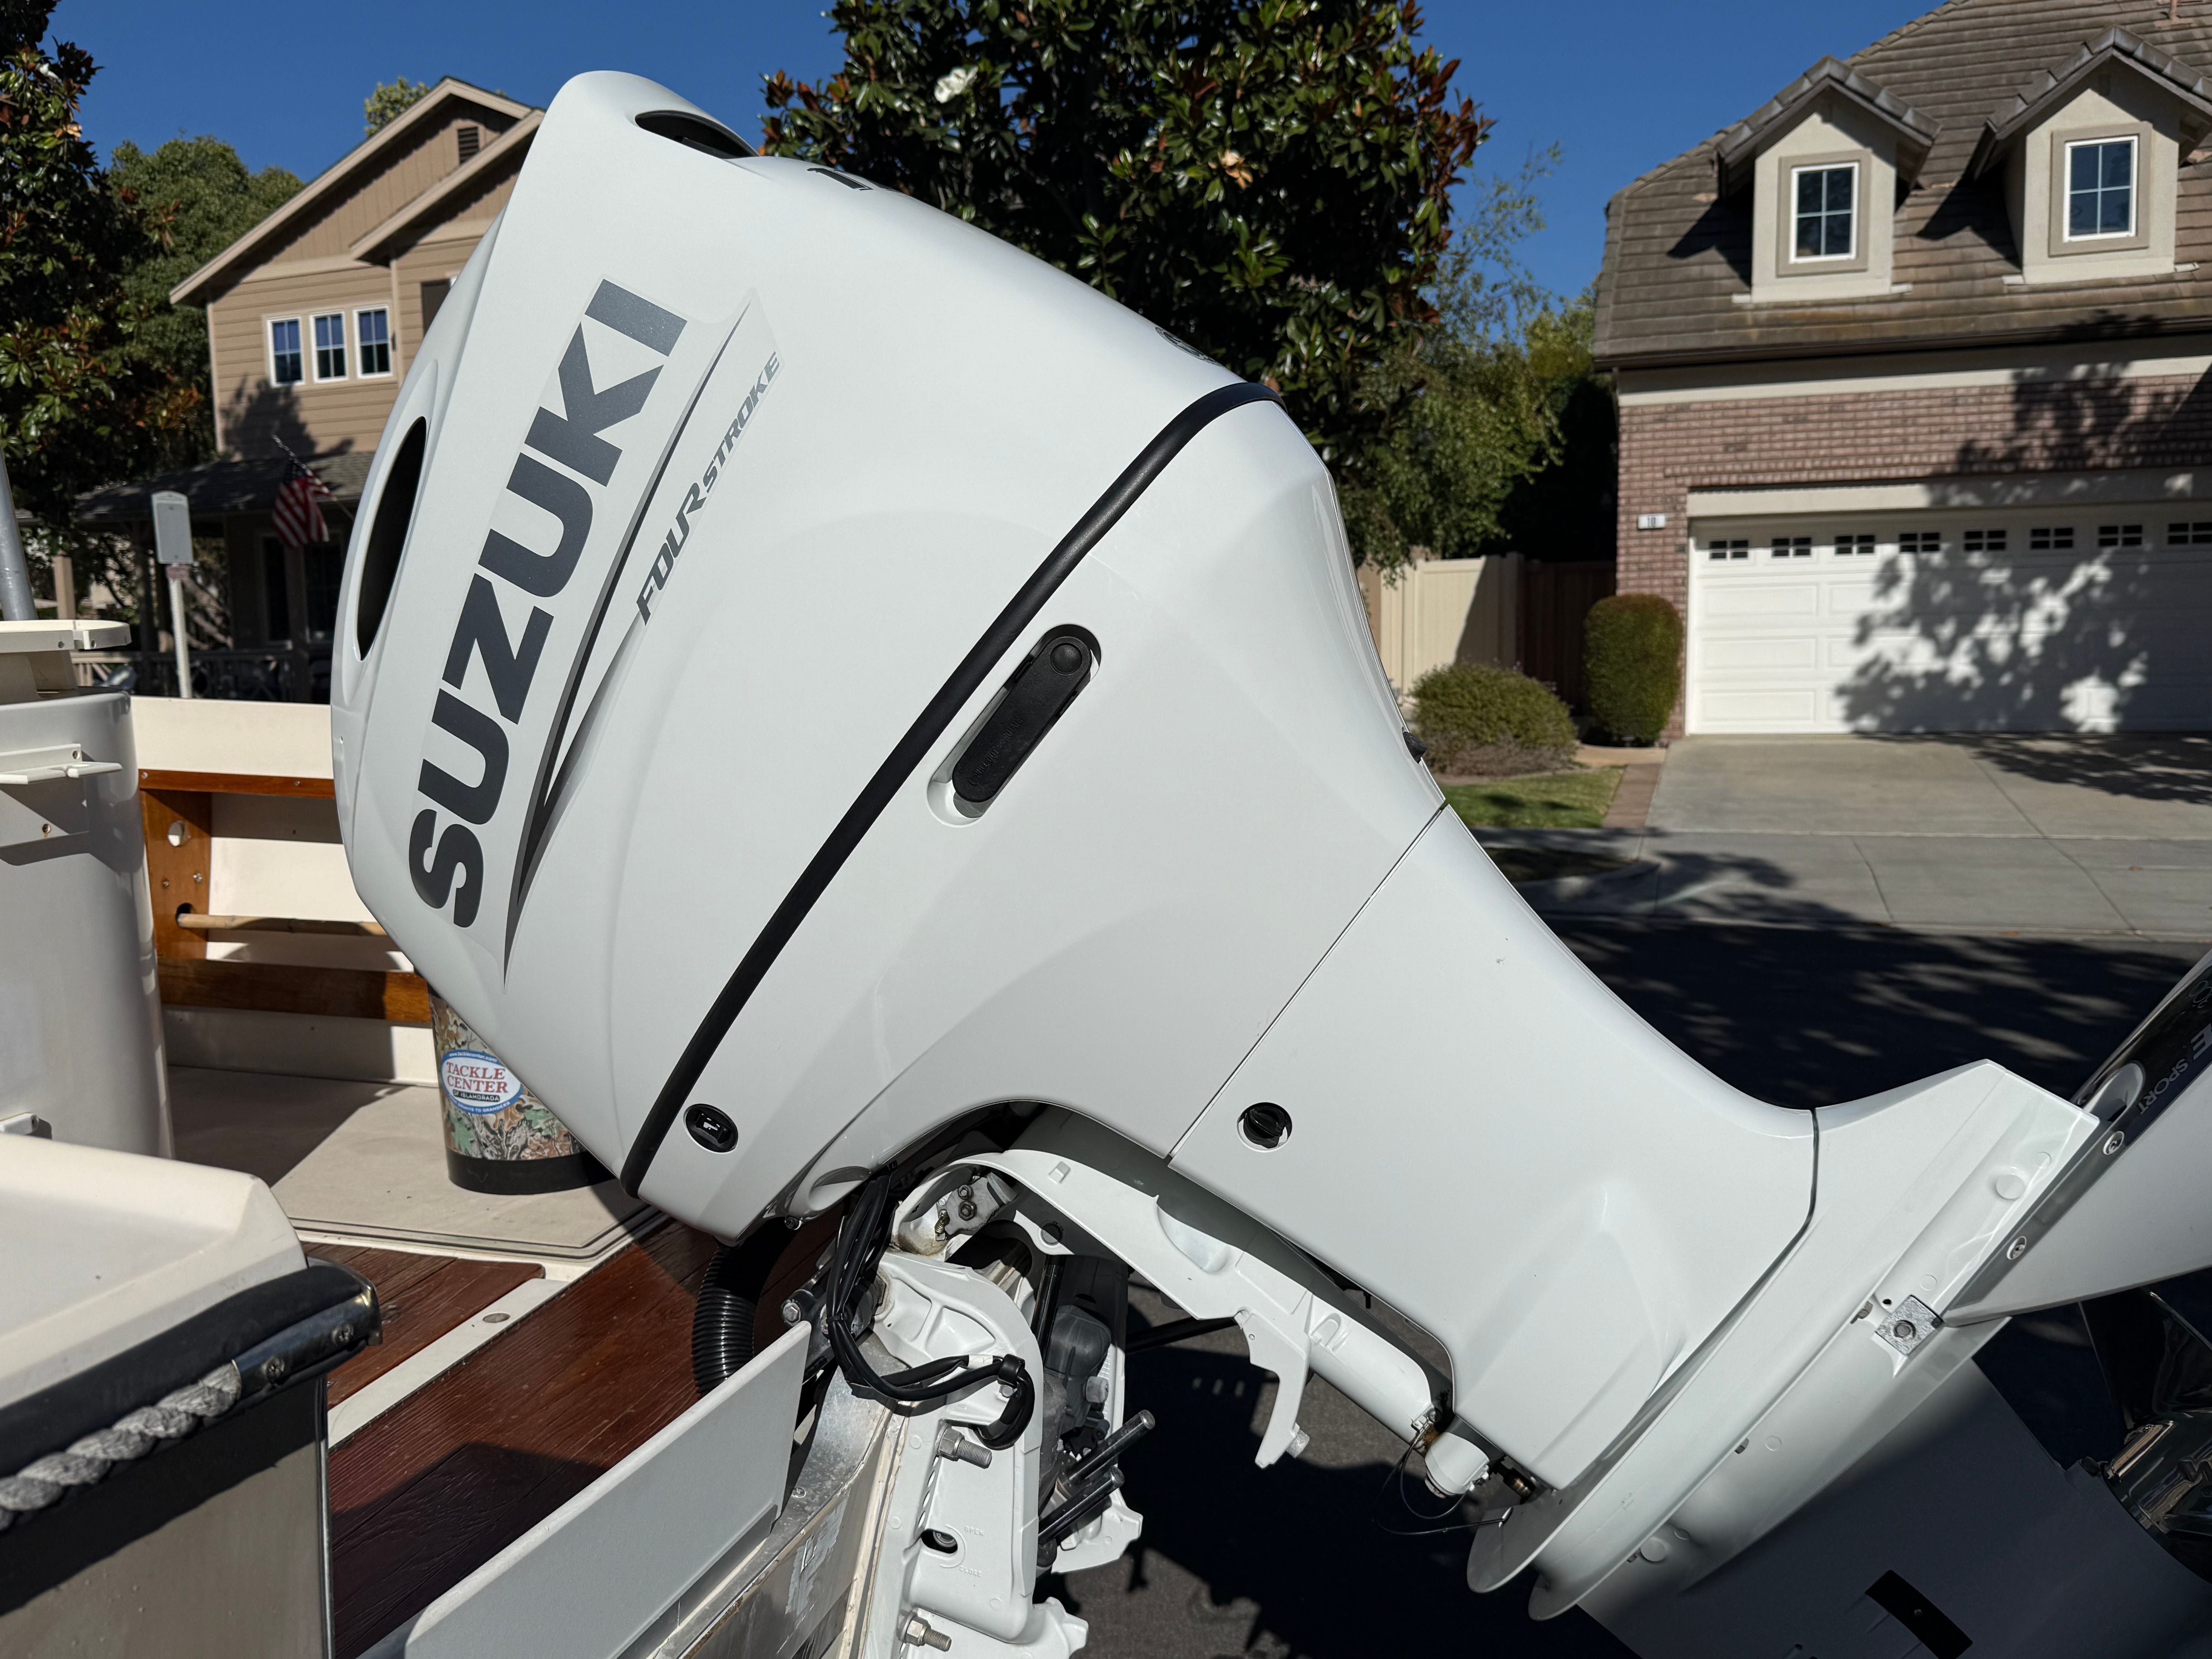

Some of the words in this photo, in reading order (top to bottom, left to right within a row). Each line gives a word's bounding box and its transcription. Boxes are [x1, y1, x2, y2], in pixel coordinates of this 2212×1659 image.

[636, 483, 707, 626] FOUR
[703, 351, 779, 493] STROKE
[409, 279, 687, 927] SUZUKI
[2191, 1023, 2212, 1060] E
[446, 1061, 506, 1080] TACKLE
[447, 1075, 508, 1093] CENTER
[2138, 1058, 2188, 1115] SPORT
[460, 1092, 499, 1101] ISLAMORADA
[965, 1525, 984, 1537] OPEN
[959, 1565, 982, 1577] CLOSE
